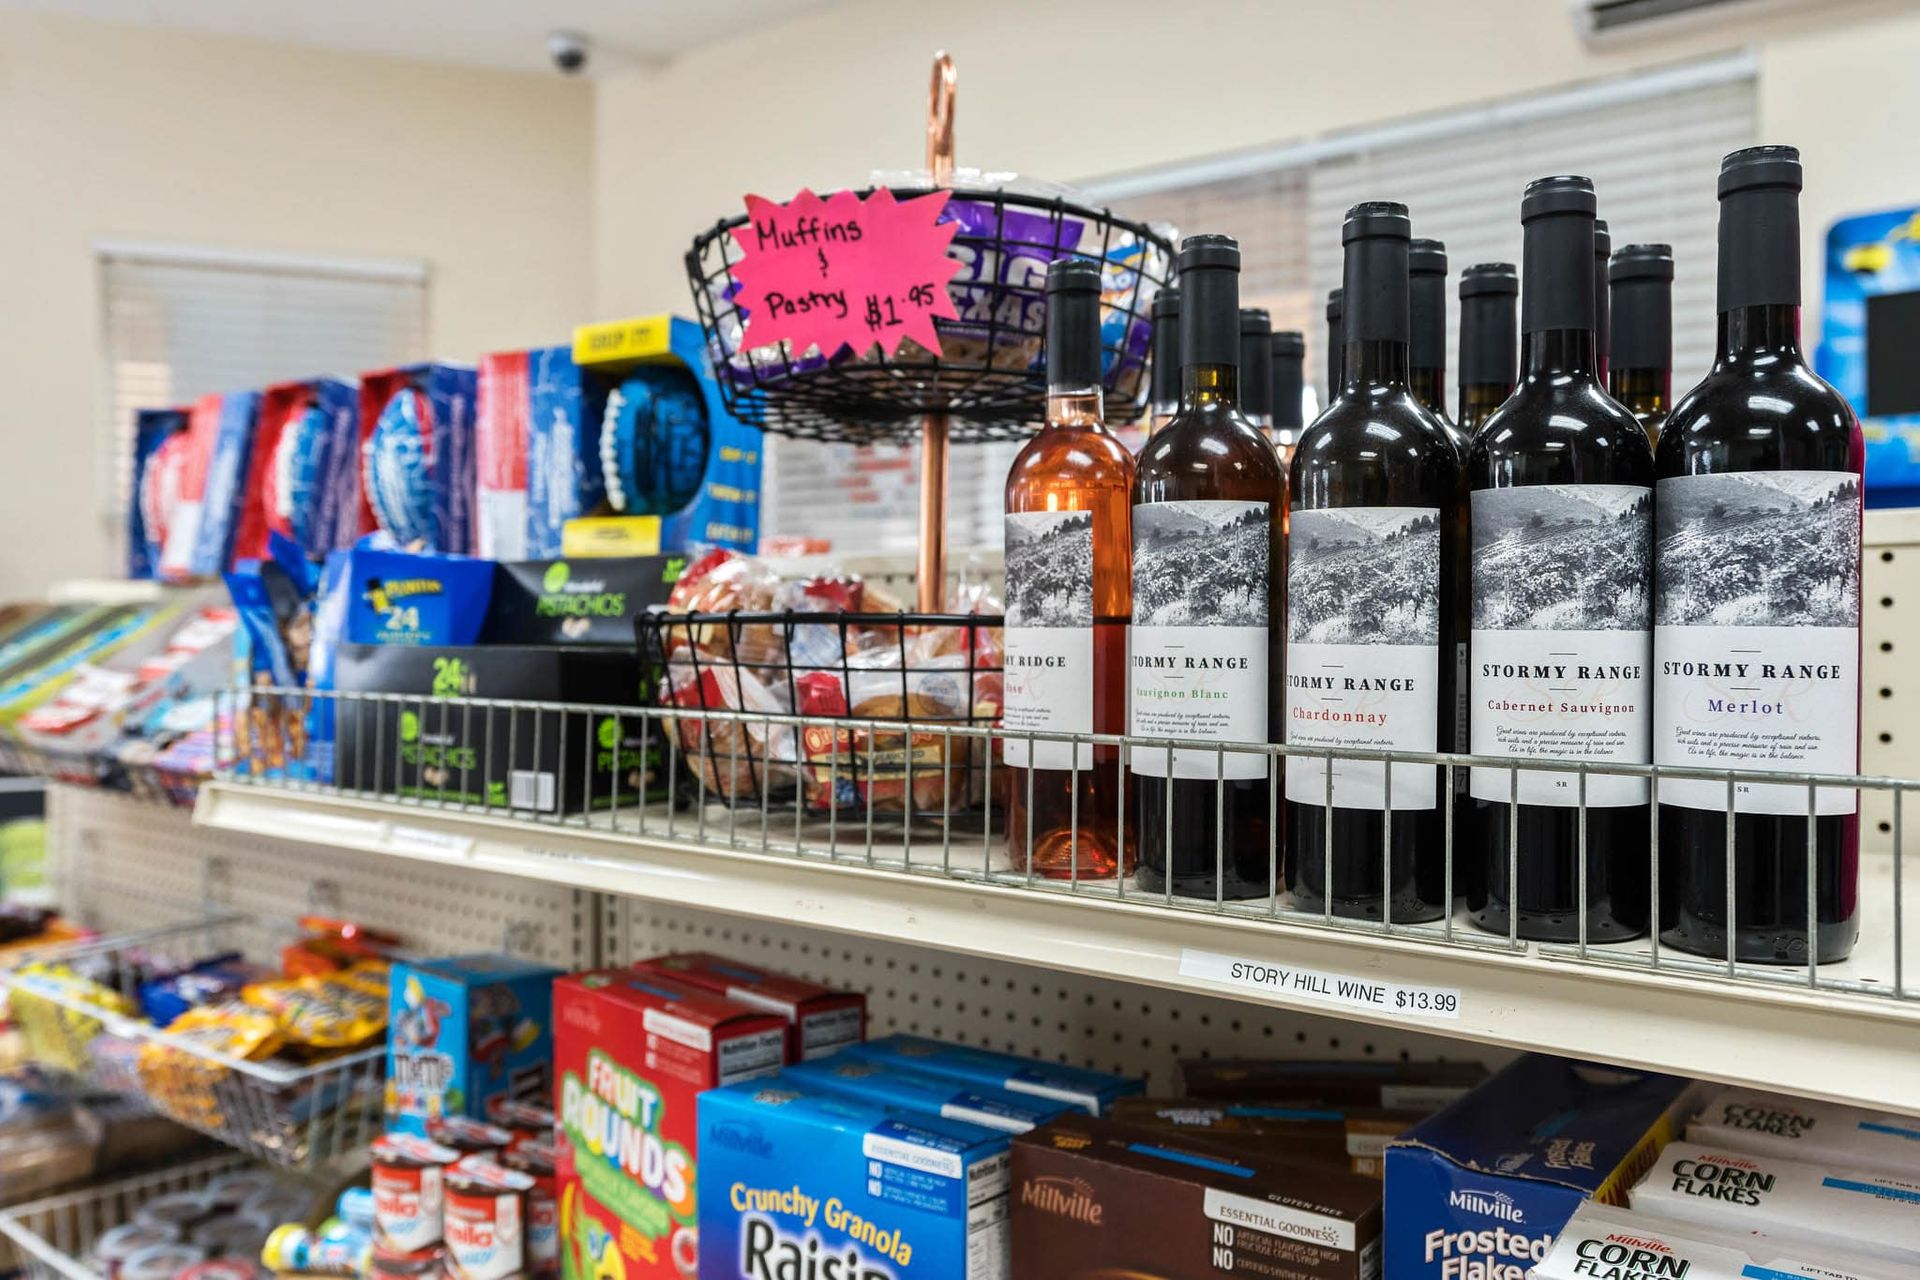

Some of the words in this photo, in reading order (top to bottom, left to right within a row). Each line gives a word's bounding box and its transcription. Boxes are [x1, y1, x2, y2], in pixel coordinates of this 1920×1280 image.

[756, 218, 862, 252] Muffins
[764, 290, 848, 320] Pastry
[865, 284, 935, 332] $1.95
[947, 285, 1046, 331] EXAS
[385, 606, 418, 630] 24
[432, 657, 461, 688] 24
[1019, 656, 1066, 667] RIDGE
[1185, 656, 1249, 670] RANGE
[1483, 664, 1567, 680] STORMY
[1578, 666, 1641, 680] RANGE
[1663, 661, 1749, 678] STORMY
[1762, 664, 1841, 679] RANGE
[1136, 688, 1185, 700] Sauvignon
[1191, 690, 1229, 700] Blanc
[1344, 678, 1415, 691] RANGE
[1293, 706, 1388, 726] Chardonnay
[1488, 700, 1553, 712] Cabernet
[1560, 702, 1634, 715] Sauvignon
[1708, 698, 1784, 714] Merlot
[1230, 962, 1290, 987] STORY
[1294, 973, 1331, 995] HILL
[1337, 980, 1386, 1004] WINE
[1395, 990, 1457, 1012] $13.99
[589, 1055, 657, 1130] FRUIT
[1722, 1115, 1802, 1139] FLAKES
[1723, 1103, 1815, 1130] CORN
[563, 1078, 688, 1204] ROUNDS
[1672, 1159, 1777, 1193] CORN
[1874, 1178, 1892, 1186] LIFT
[1020, 1179, 1104, 1227] Millville
[1671, 1176, 1762, 1207] FLAKES
[1268, 1194, 1313, 1209] GLUTEN
[1315, 1204, 1344, 1216] FREE
[1450, 1190, 1526, 1224] Millville
[730, 1181, 819, 1227] Crunchy
[825, 1198, 912, 1266] Granola
[1214, 1223, 1234, 1247] NO
[1220, 1206, 1275, 1229] ESSENTIAL
[1279, 1221, 1335, 1243] GOODNESS
[746, 1218, 890, 1280] Raisi
[1424, 1226, 1552, 1264] Frosted
[1606, 1233, 1674, 1254] Millville
[1213, 1247, 1233, 1270] NO
[1441, 1256, 1537, 1280] Flake
[1575, 1239, 1691, 1279] CORN
[1801, 1266, 1821, 1274] LIFT
[1824, 1271, 1843, 1279] TAB
